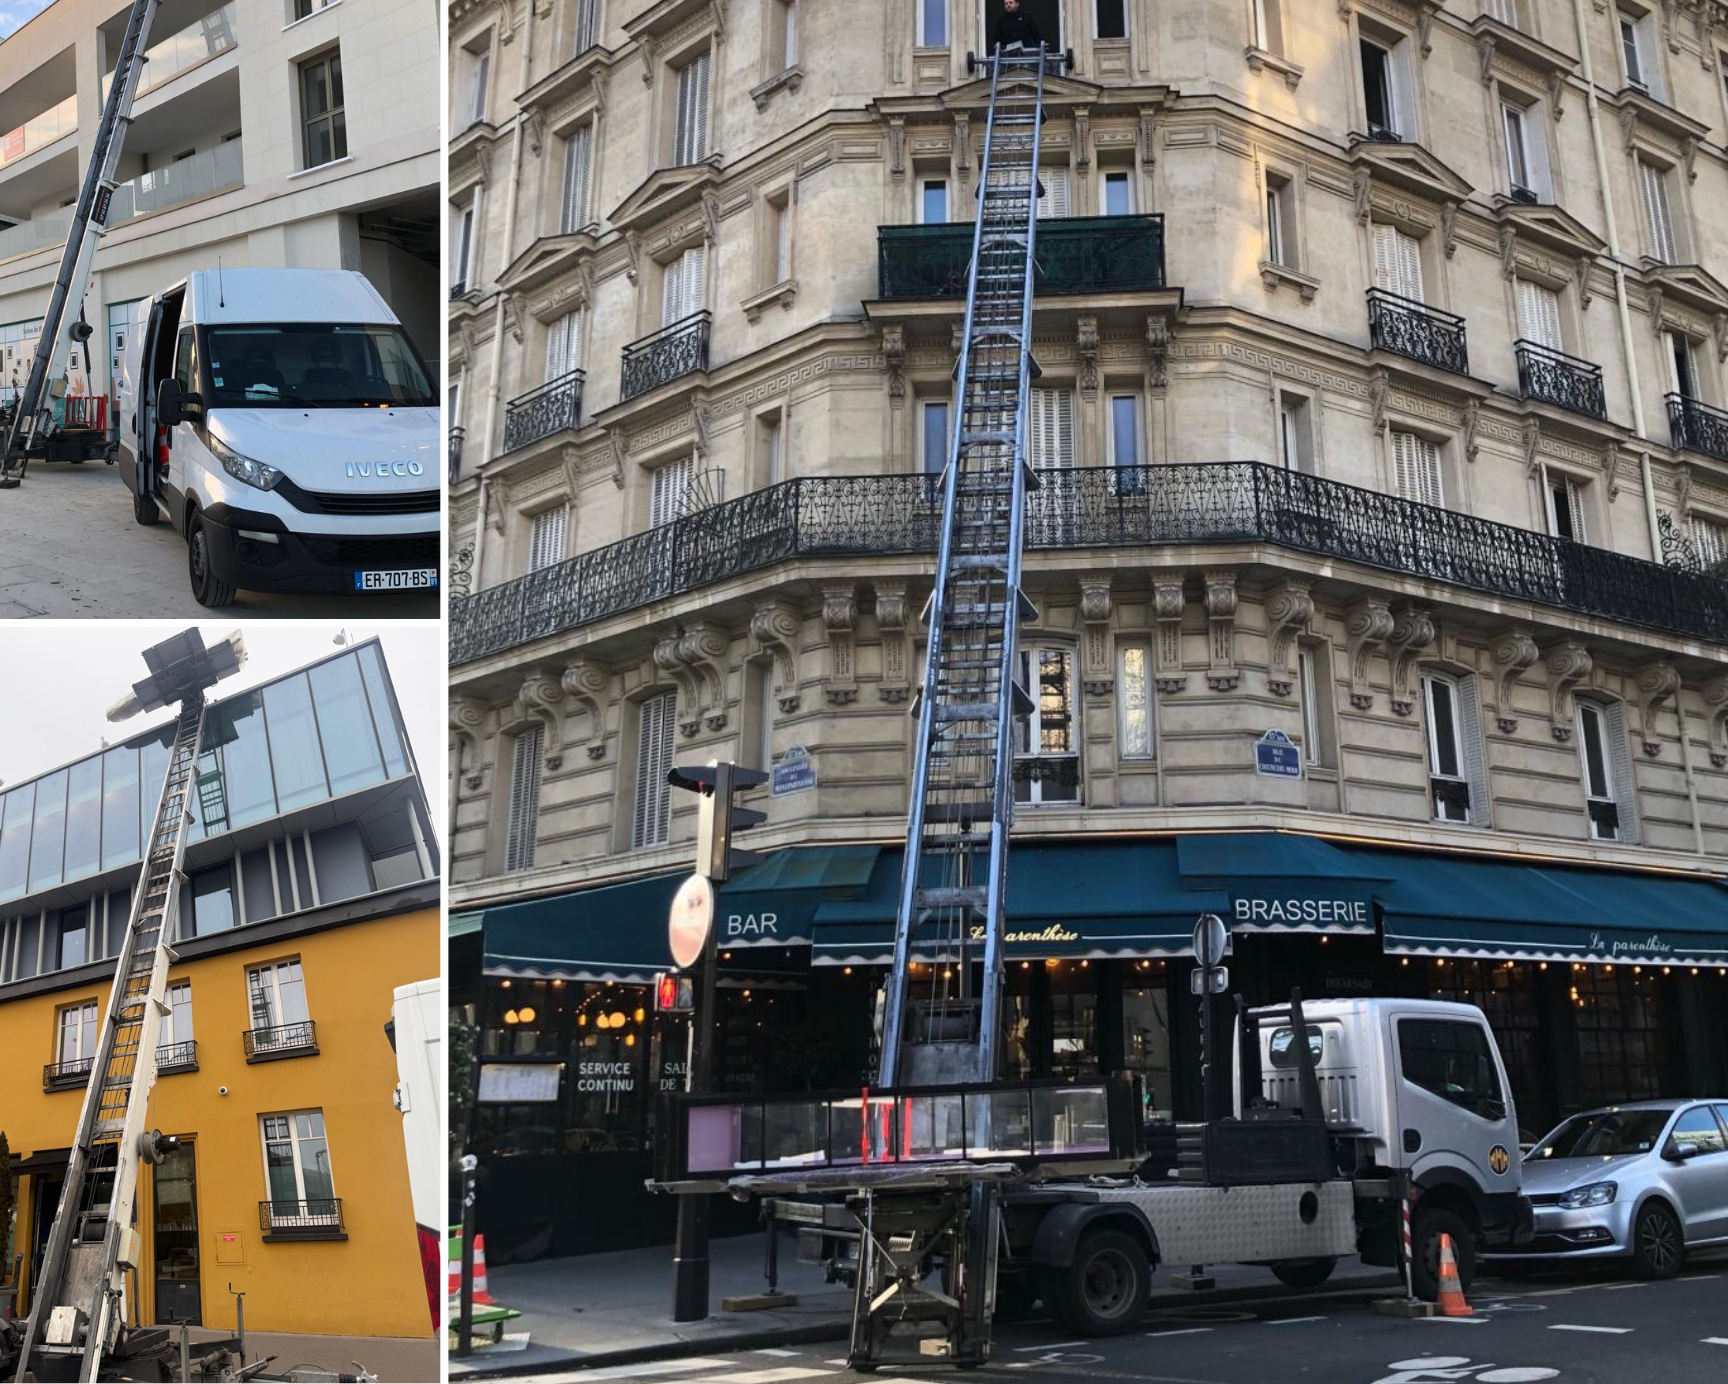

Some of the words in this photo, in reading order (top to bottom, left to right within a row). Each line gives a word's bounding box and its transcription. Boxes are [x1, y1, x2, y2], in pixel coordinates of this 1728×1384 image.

[345, 460, 423, 477] IVECO
[1235, 899, 1368, 922] BRASSERIE
[727, 912, 778, 936] BAR
[1004, 923, 1078, 942] arenthèse
[579, 1062, 631, 1075] SERVICE
[664, 1062, 693, 1075] SAL
[577, 1078, 634, 1092] CONTINU
